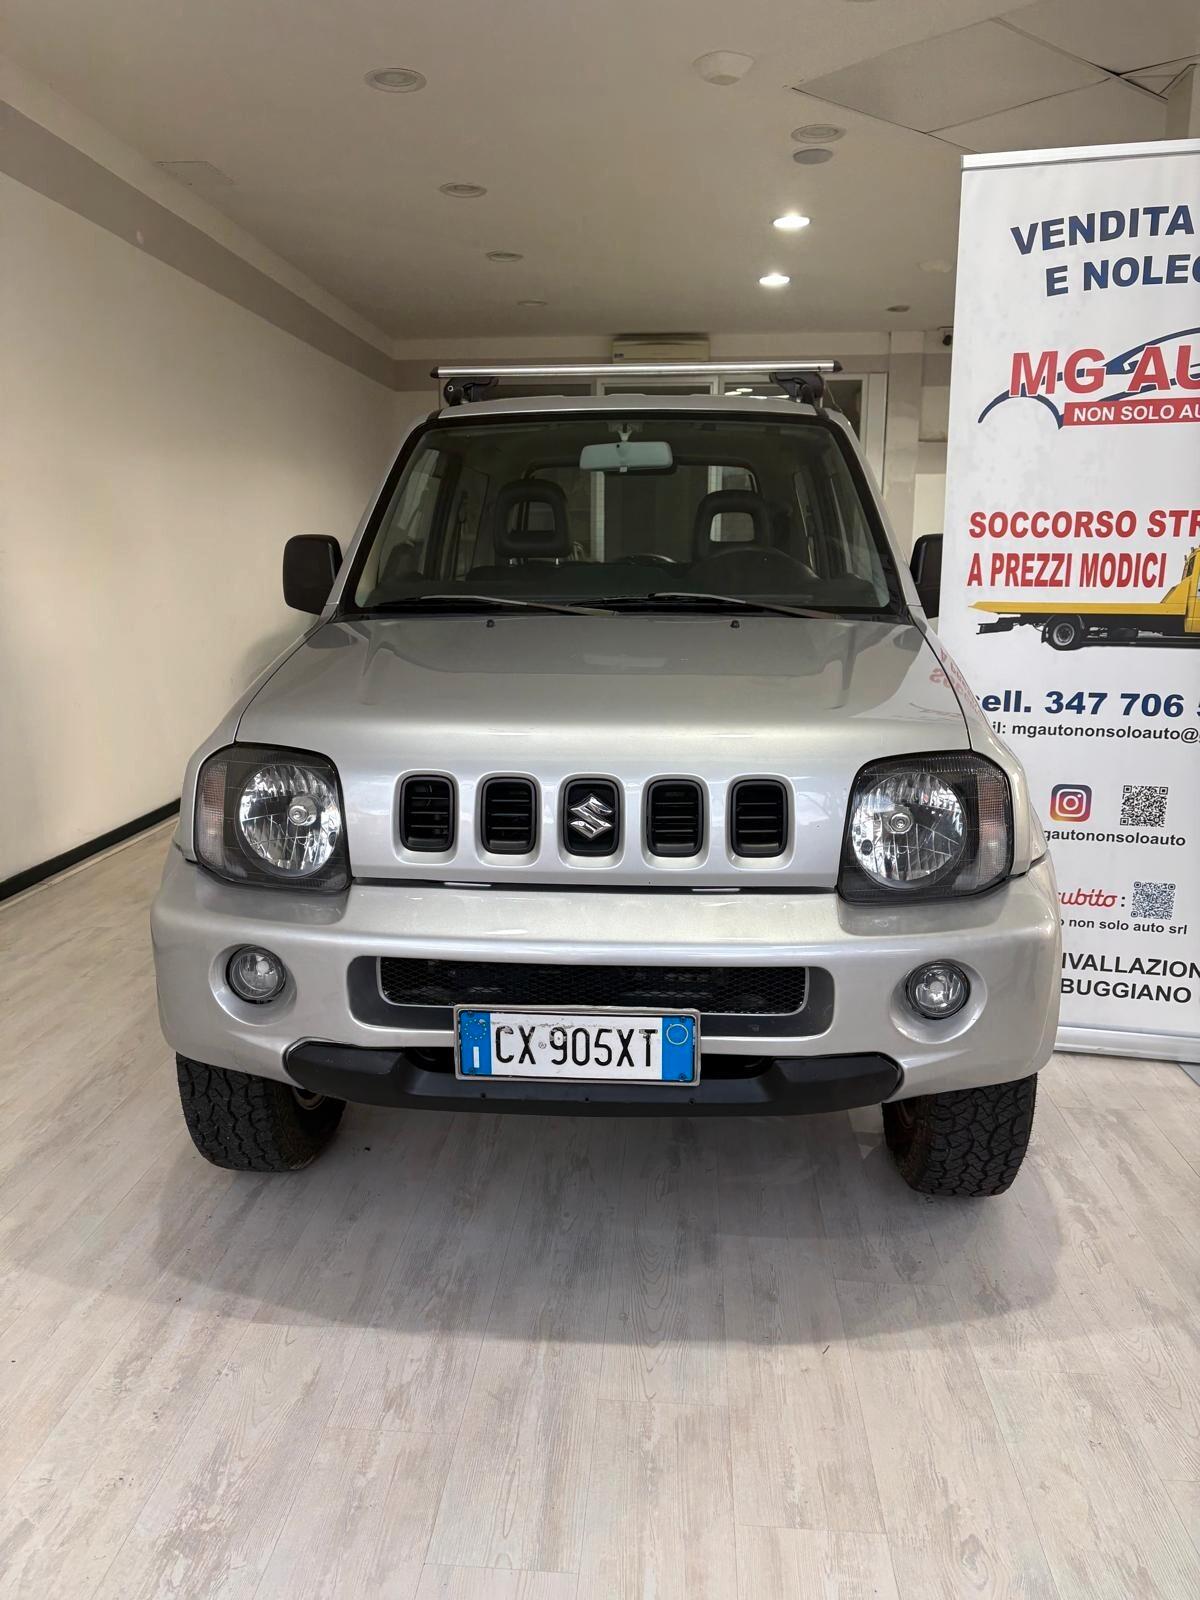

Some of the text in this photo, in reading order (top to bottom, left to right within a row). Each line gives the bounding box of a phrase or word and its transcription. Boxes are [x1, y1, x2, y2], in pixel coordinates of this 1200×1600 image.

[1010, 204, 1195, 256] VENDITA
[1046, 265, 1069, 297] E
[1009, 348, 1106, 397] MG
[1073, 407, 1115, 422] NON
[1121, 404, 1175, 421] SOLO
[969, 510, 1137, 538] SOCCORSO
[967, 552, 1168, 588] A PREZZI MODICI
[976, 690, 1032, 713] ell.
[1044, 691, 1108, 715] 347
[1120, 693, 1185, 718] 706
[1058, 887, 1118, 908] ubito
[1069, 919, 1095, 929] non
[1099, 919, 1129, 932] solo
[1133, 921, 1165, 934] auto
[1168, 923, 1188, 935] srl
[1060, 978, 1192, 1004] BUGGIANO
[495, 1025, 537, 1065] CX
[549, 1026, 659, 1067] 905XT
